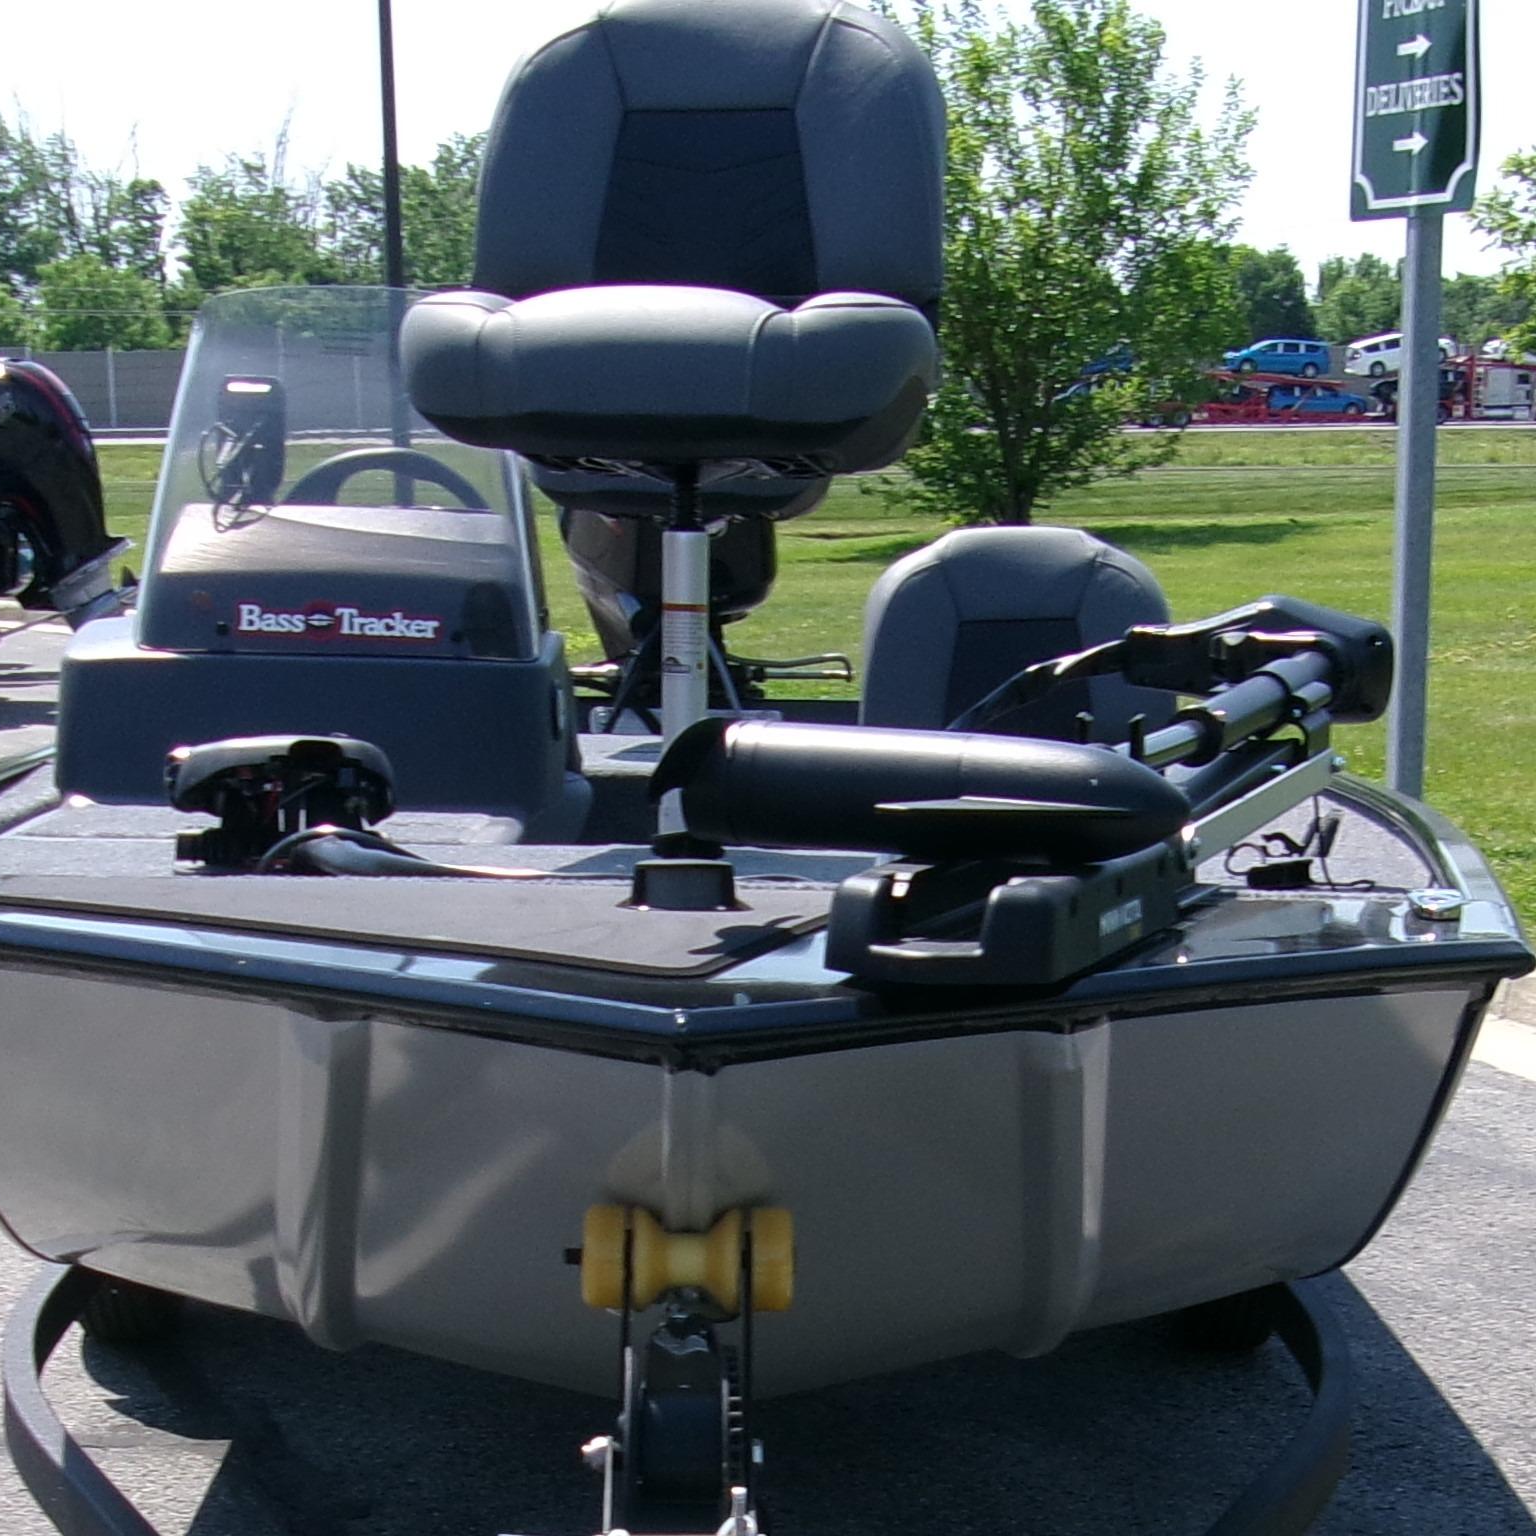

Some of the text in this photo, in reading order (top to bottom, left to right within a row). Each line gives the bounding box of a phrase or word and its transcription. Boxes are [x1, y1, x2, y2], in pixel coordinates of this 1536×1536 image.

[1366, 72, 1464, 118] DELIVERIES
[238, 604, 440, 639] Bass Tracker
